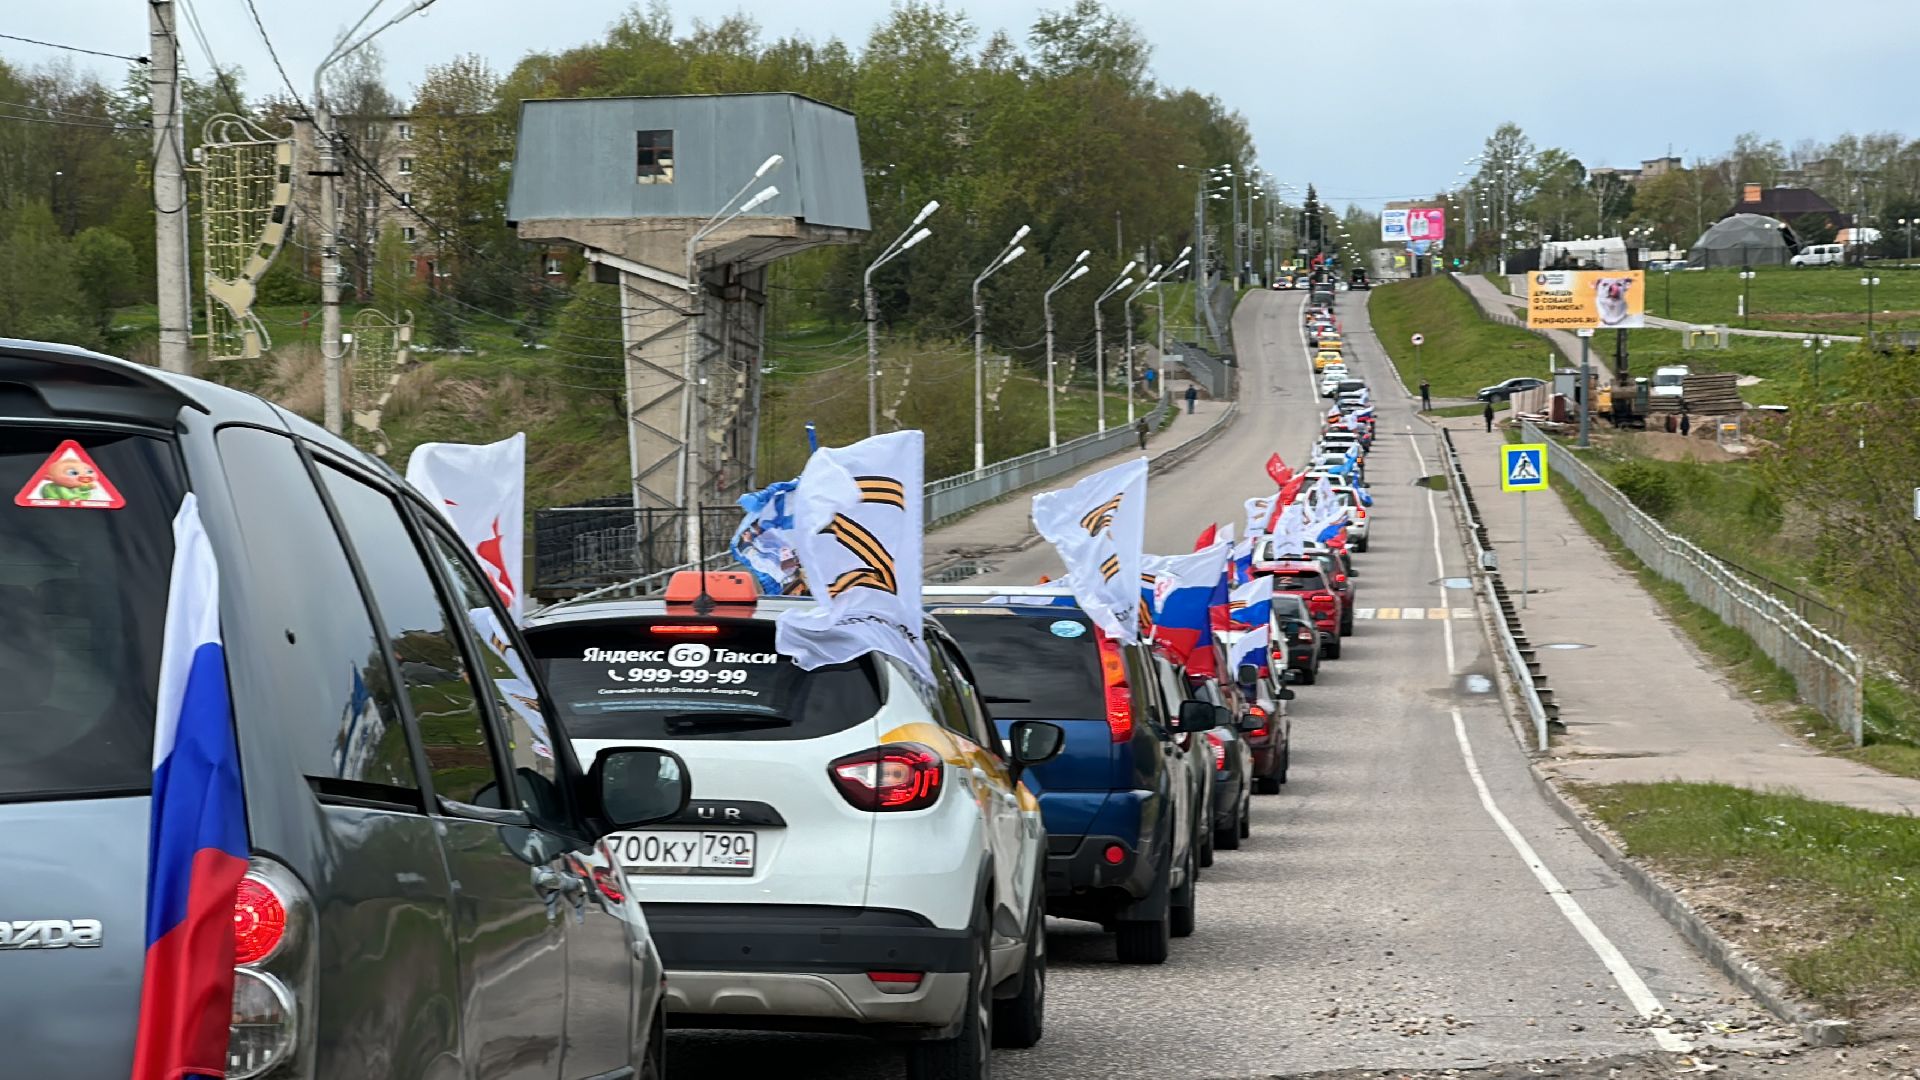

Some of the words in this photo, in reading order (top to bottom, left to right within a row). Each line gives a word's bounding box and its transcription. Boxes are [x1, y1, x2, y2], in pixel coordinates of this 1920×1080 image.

[582, 647, 664, 664] Яндекс
[674, 648, 703, 662] Go
[713, 648, 778, 664] Такси
[627, 668, 748, 684] 999-99-99
[697, 807, 742, 819] UR
[607, 835, 698, 862] 700КУ
[704, 834, 746, 855] 790
[712, 856, 733, 864] RUS
